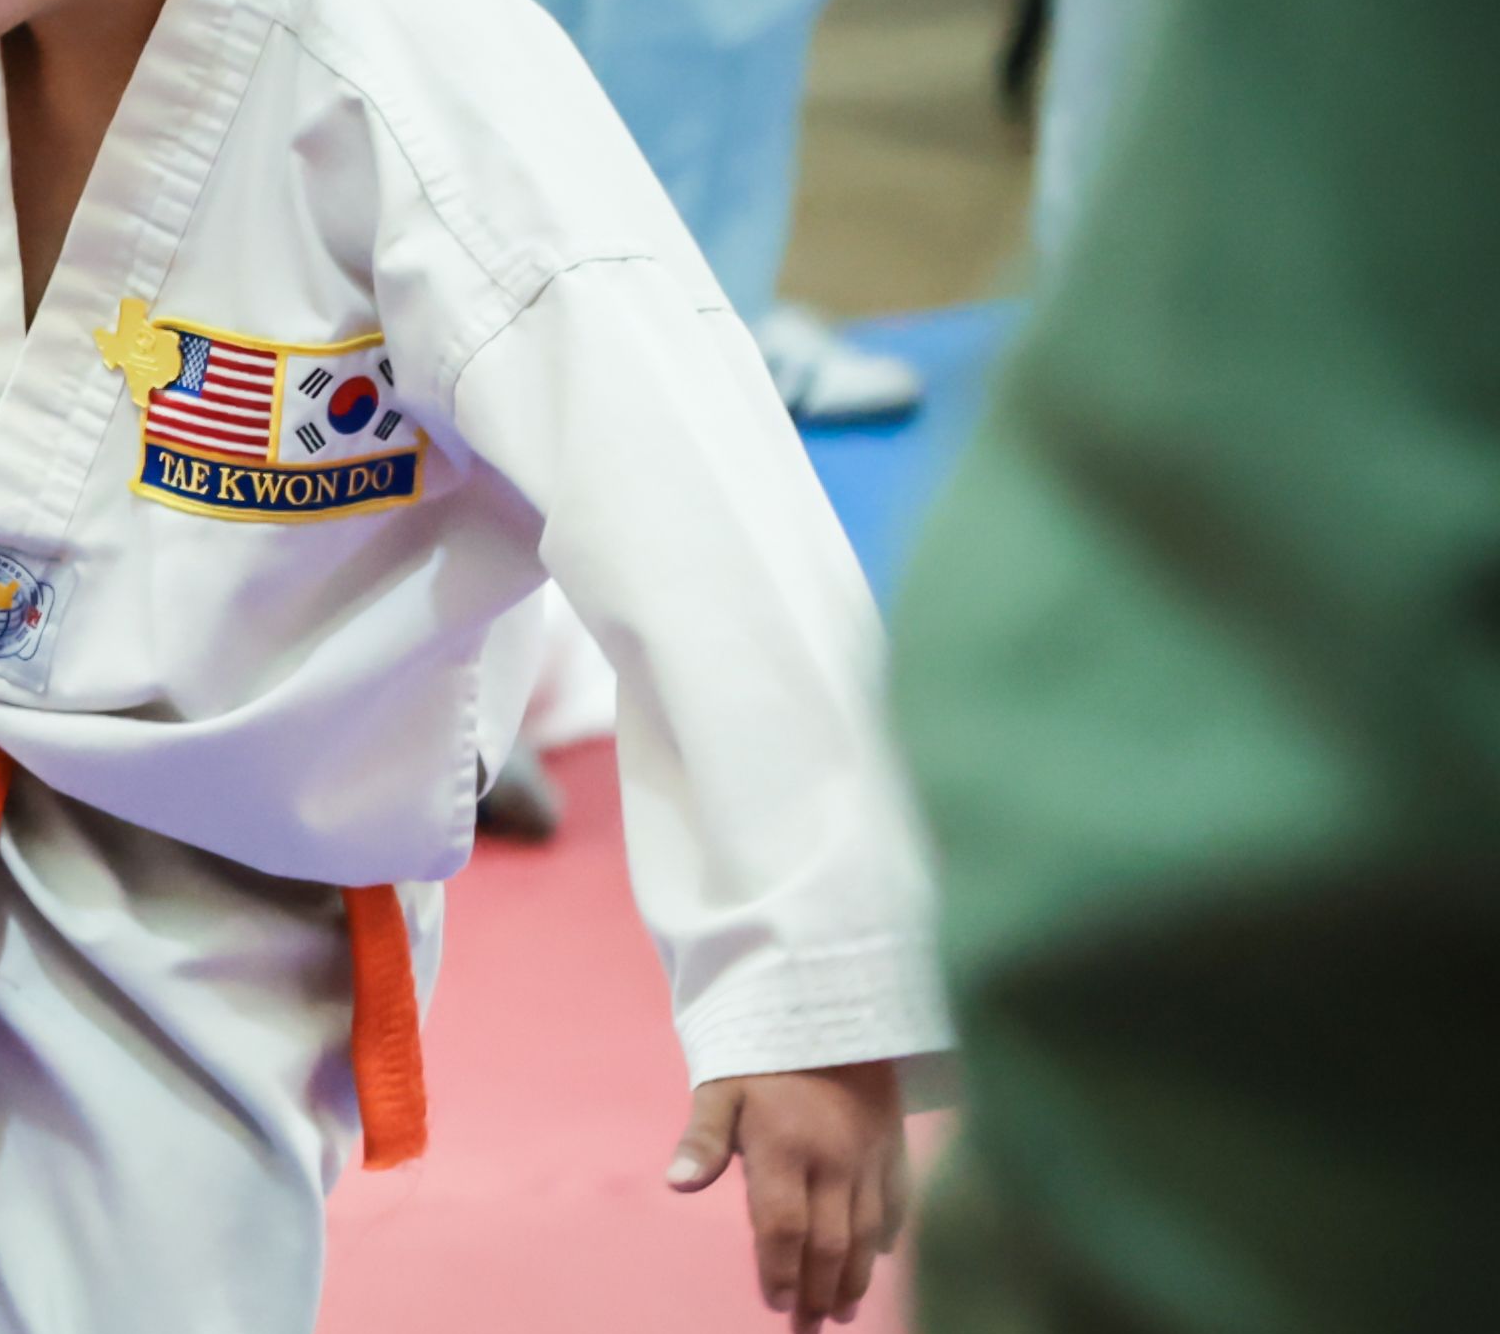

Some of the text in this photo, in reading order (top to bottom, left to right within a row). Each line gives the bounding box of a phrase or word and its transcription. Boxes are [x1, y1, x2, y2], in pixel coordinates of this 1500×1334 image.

[158, 451, 395, 506] TAE KWON DO
